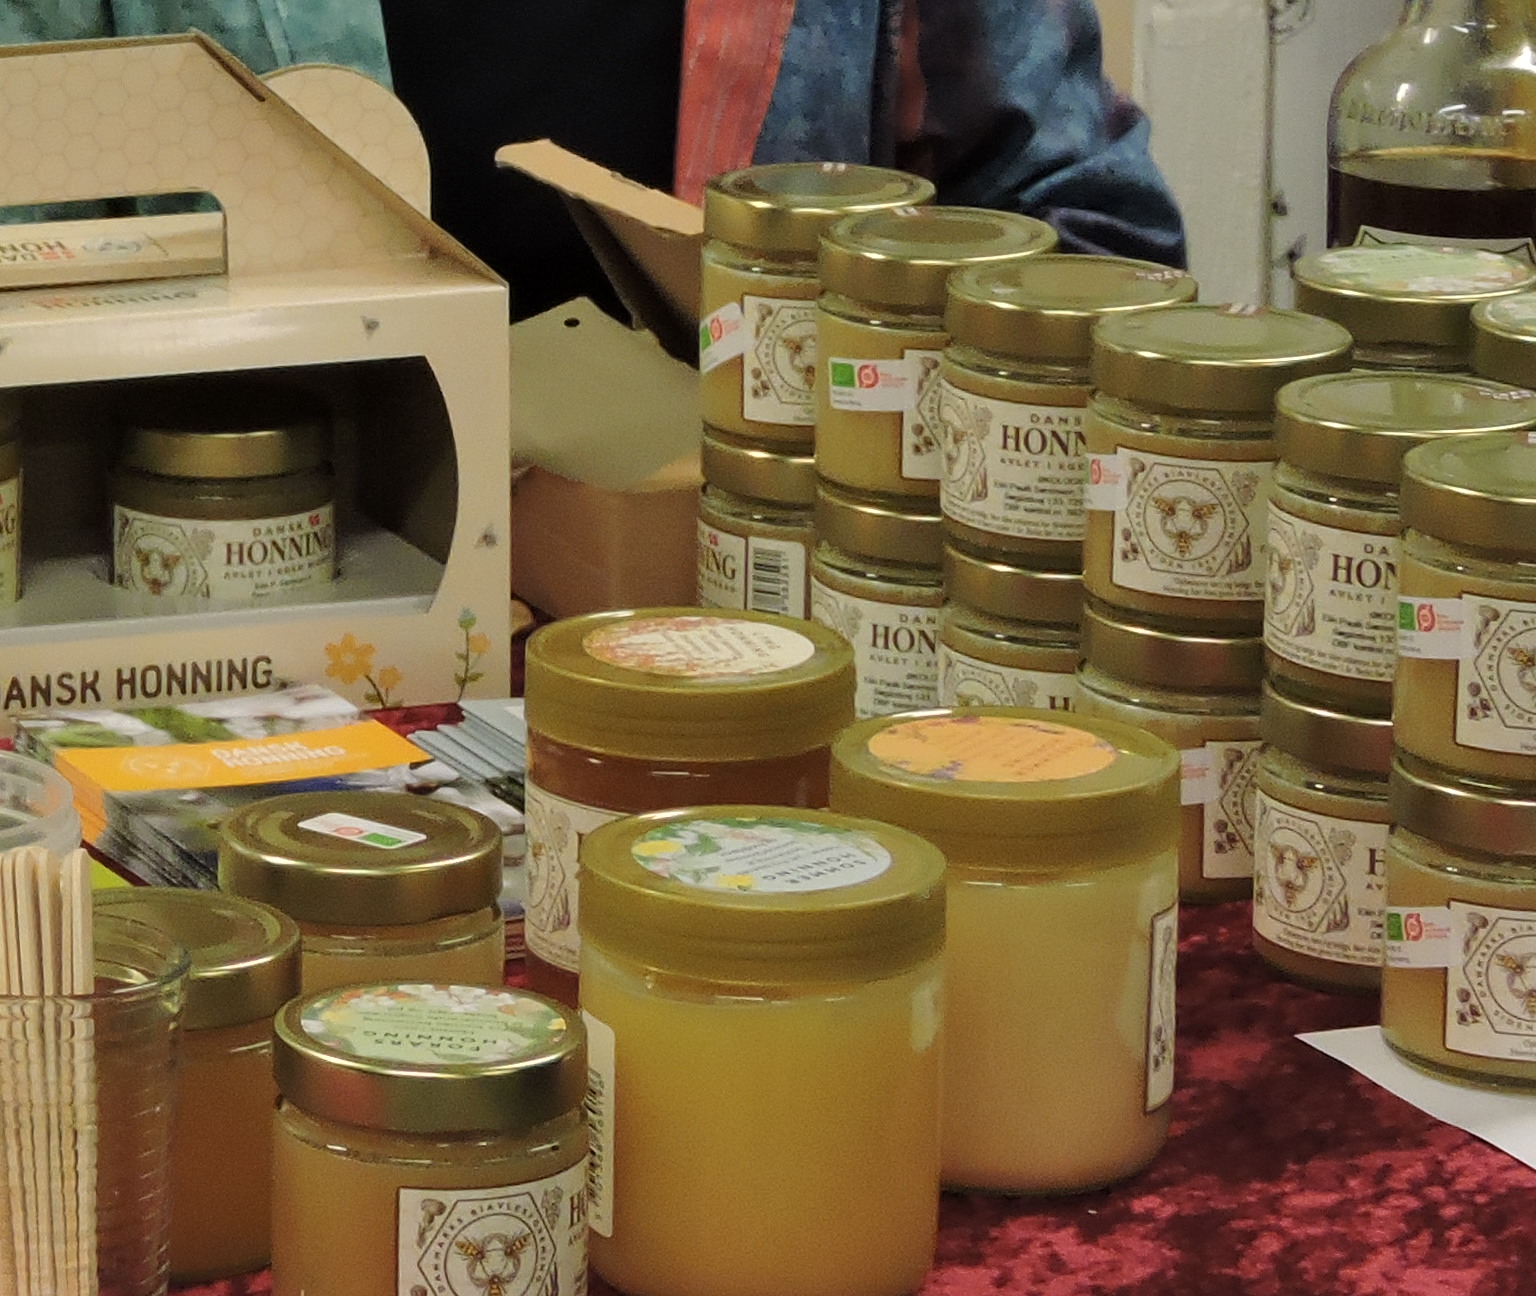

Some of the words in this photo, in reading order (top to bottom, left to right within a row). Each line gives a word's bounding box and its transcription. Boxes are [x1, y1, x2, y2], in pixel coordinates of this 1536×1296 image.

[1000, 423, 1090, 458] HONN
[224, 524, 331, 567] HONNIN
[115, 655, 274, 701] HONNING
